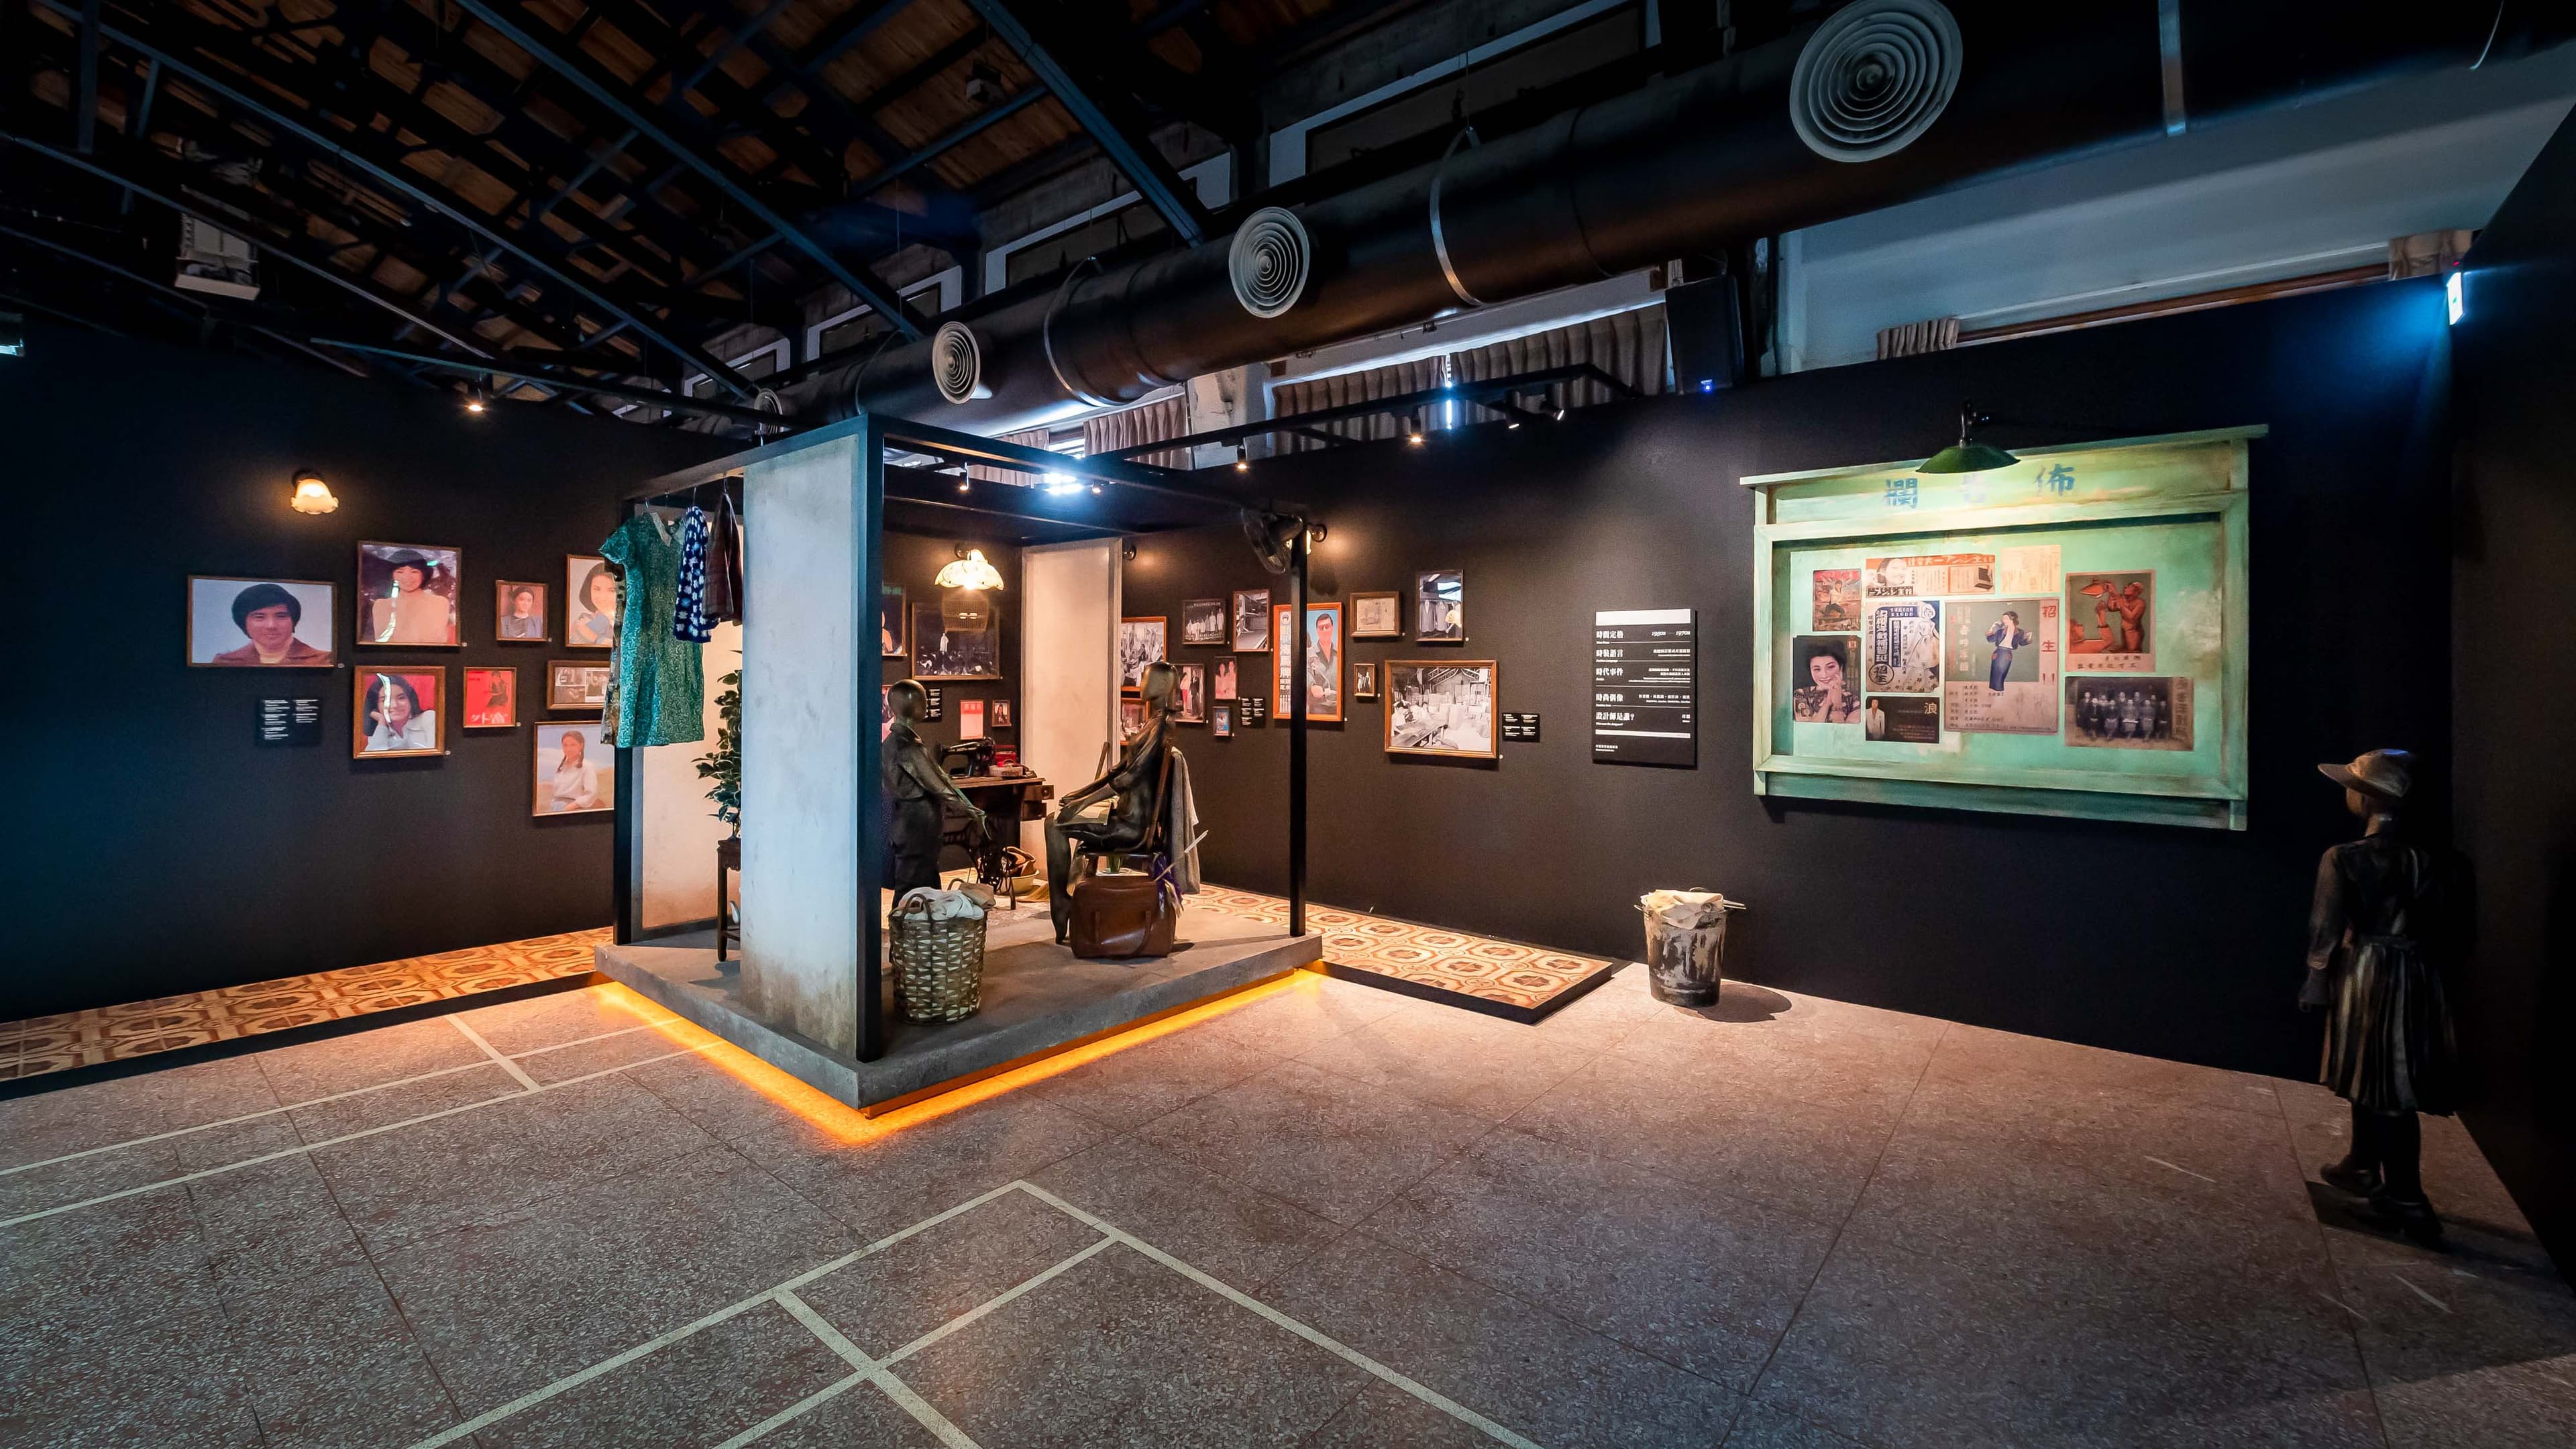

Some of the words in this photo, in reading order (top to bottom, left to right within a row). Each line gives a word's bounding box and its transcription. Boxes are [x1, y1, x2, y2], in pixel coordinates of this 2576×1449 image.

[1595, 667, 1623, 676] 時代事件
[1924, 702, 1937, 714] 浪
